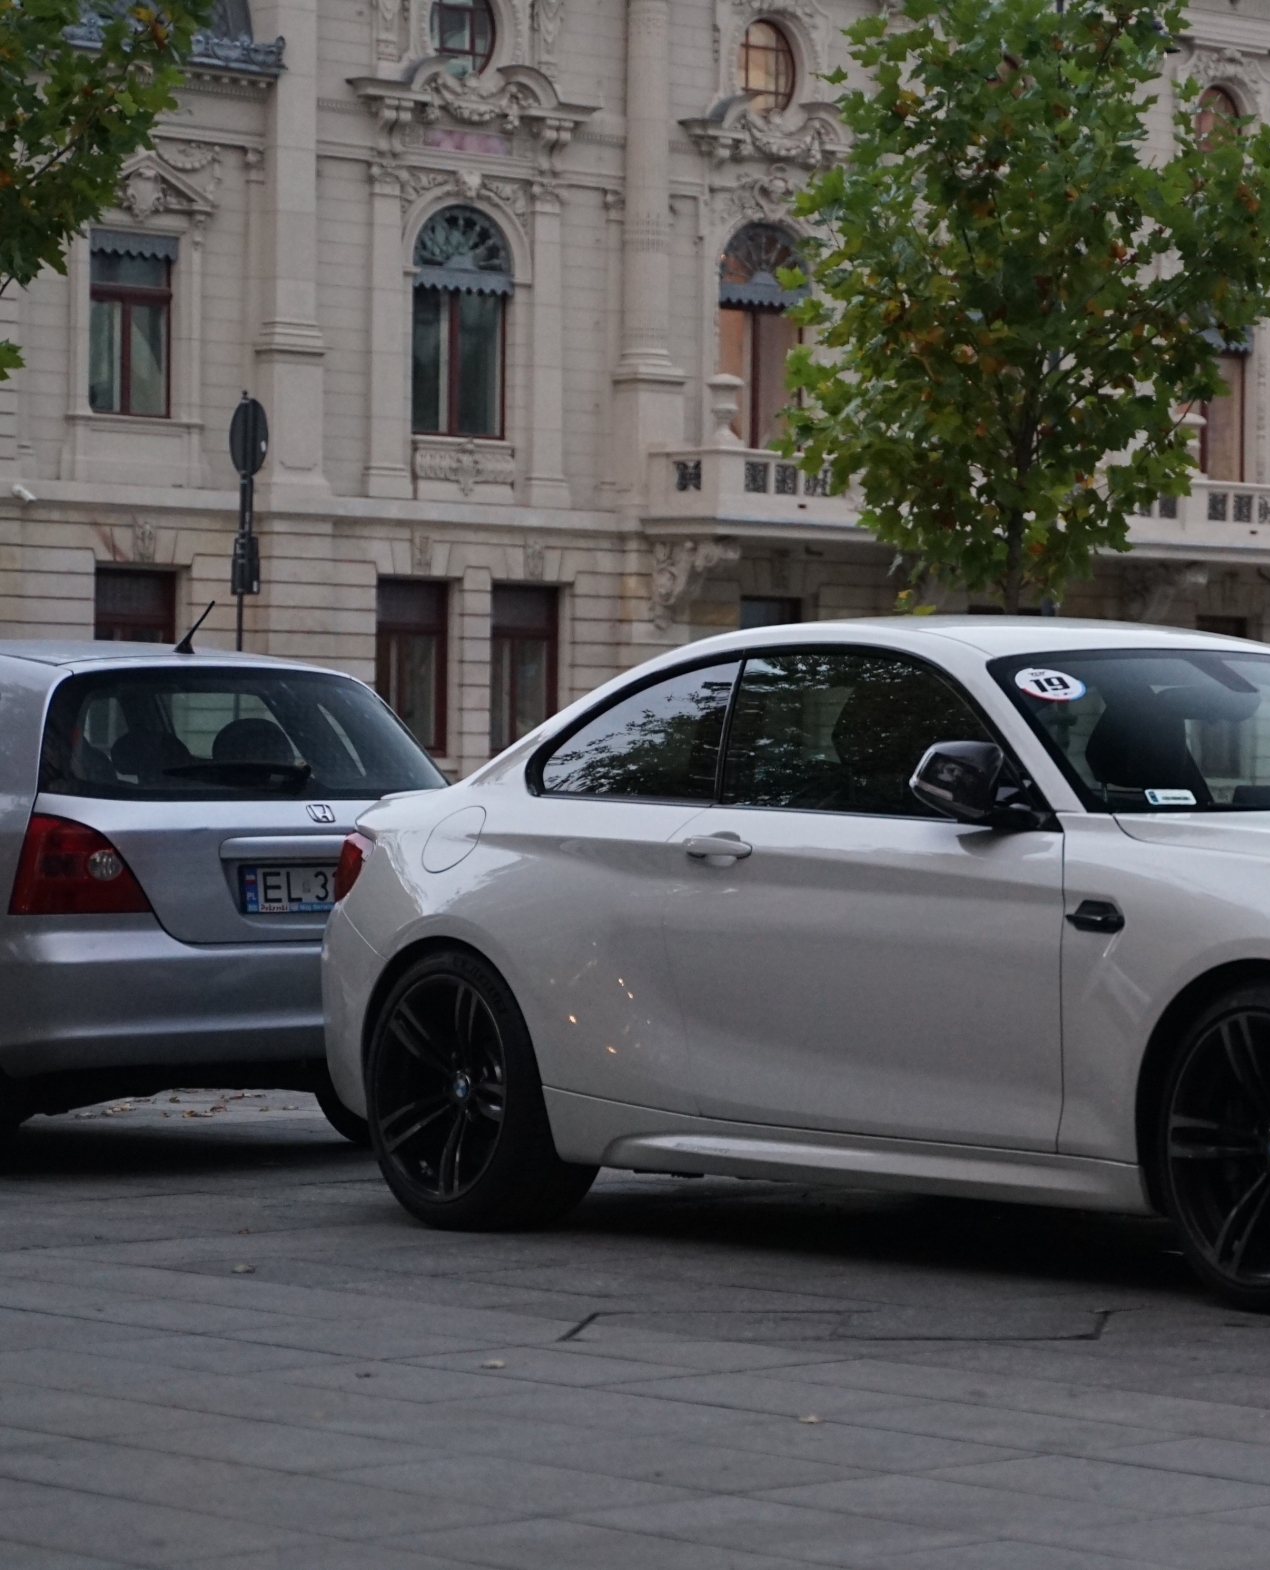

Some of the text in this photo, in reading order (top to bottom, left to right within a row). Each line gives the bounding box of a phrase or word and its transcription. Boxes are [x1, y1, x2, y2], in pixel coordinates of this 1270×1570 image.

[1029, 676, 1070, 693] 19
[262, 871, 336, 903] EL 3
